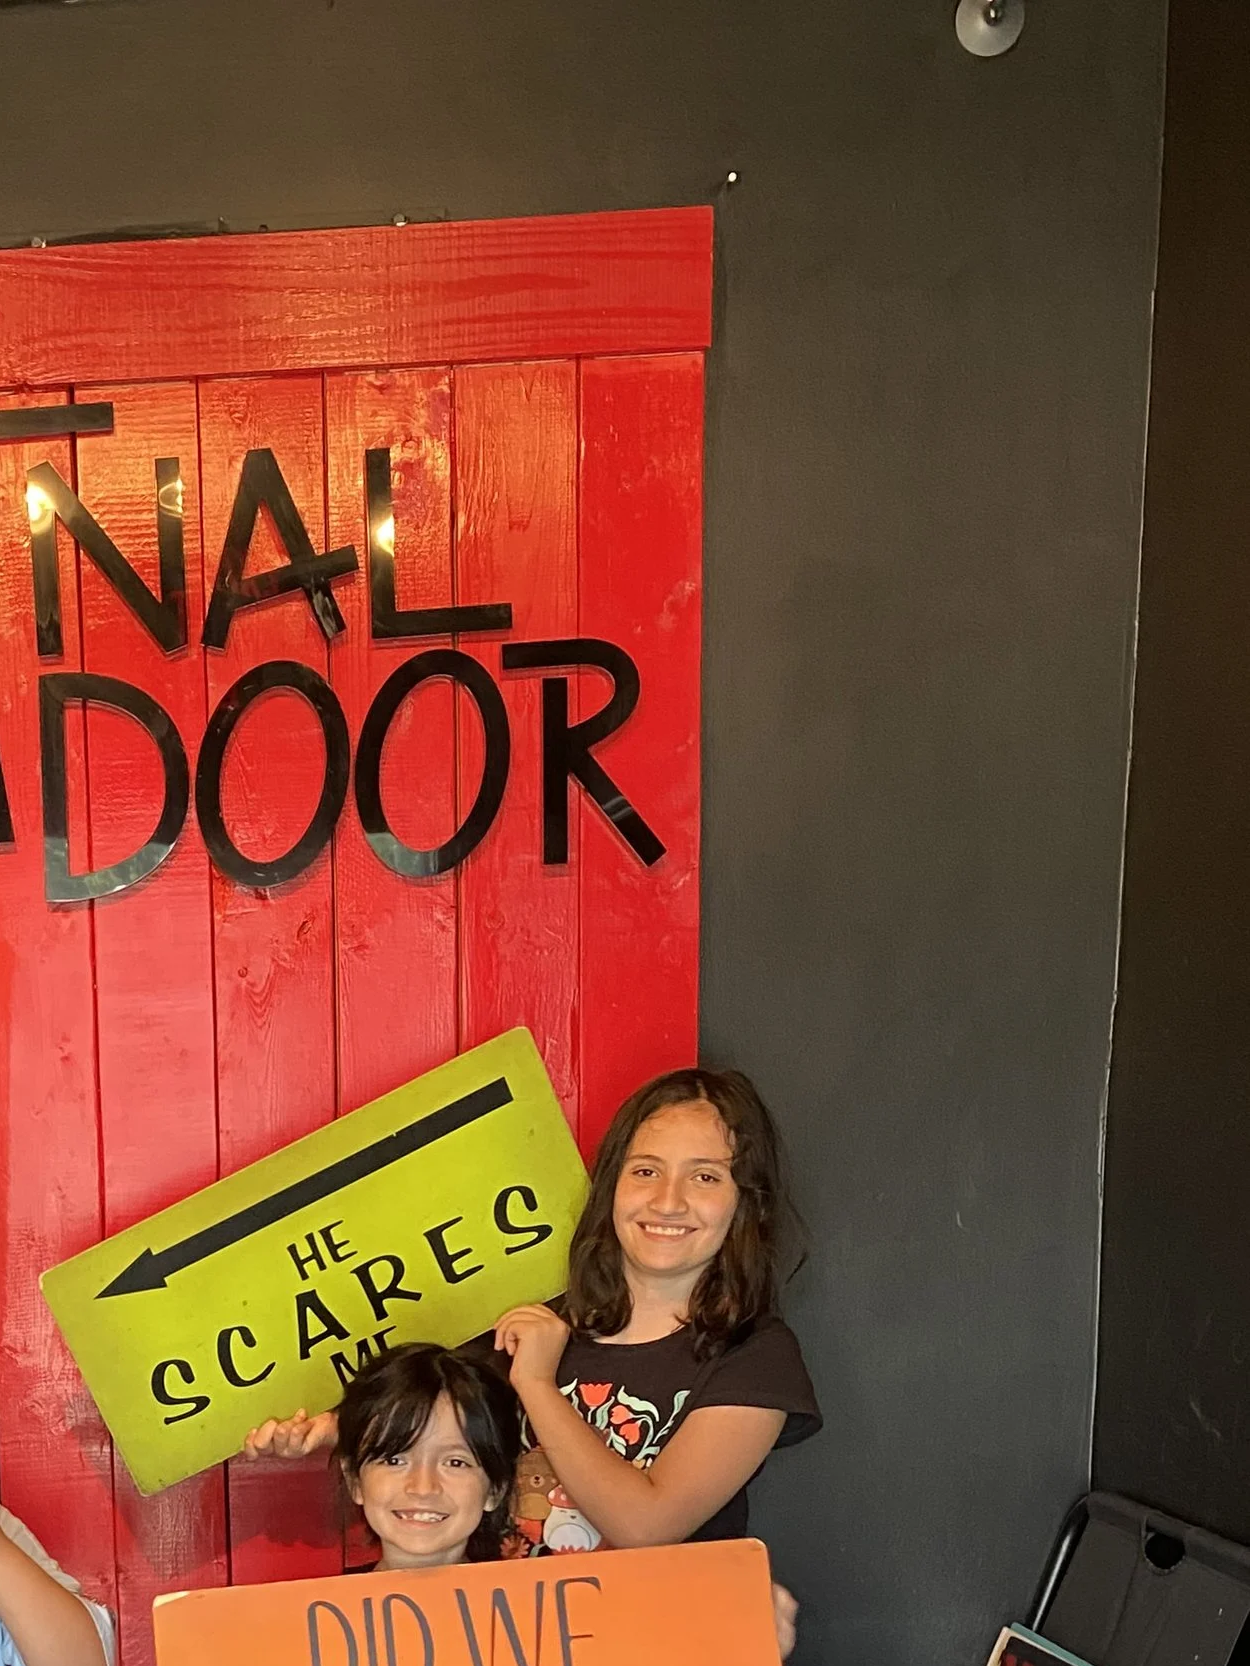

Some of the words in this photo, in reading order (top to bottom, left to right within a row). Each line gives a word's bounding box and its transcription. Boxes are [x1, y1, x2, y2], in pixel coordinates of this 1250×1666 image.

[38, 638, 666, 904] DOOR
[150, 1184, 554, 1426] SCARES
[286, 1219, 358, 1282] HE
